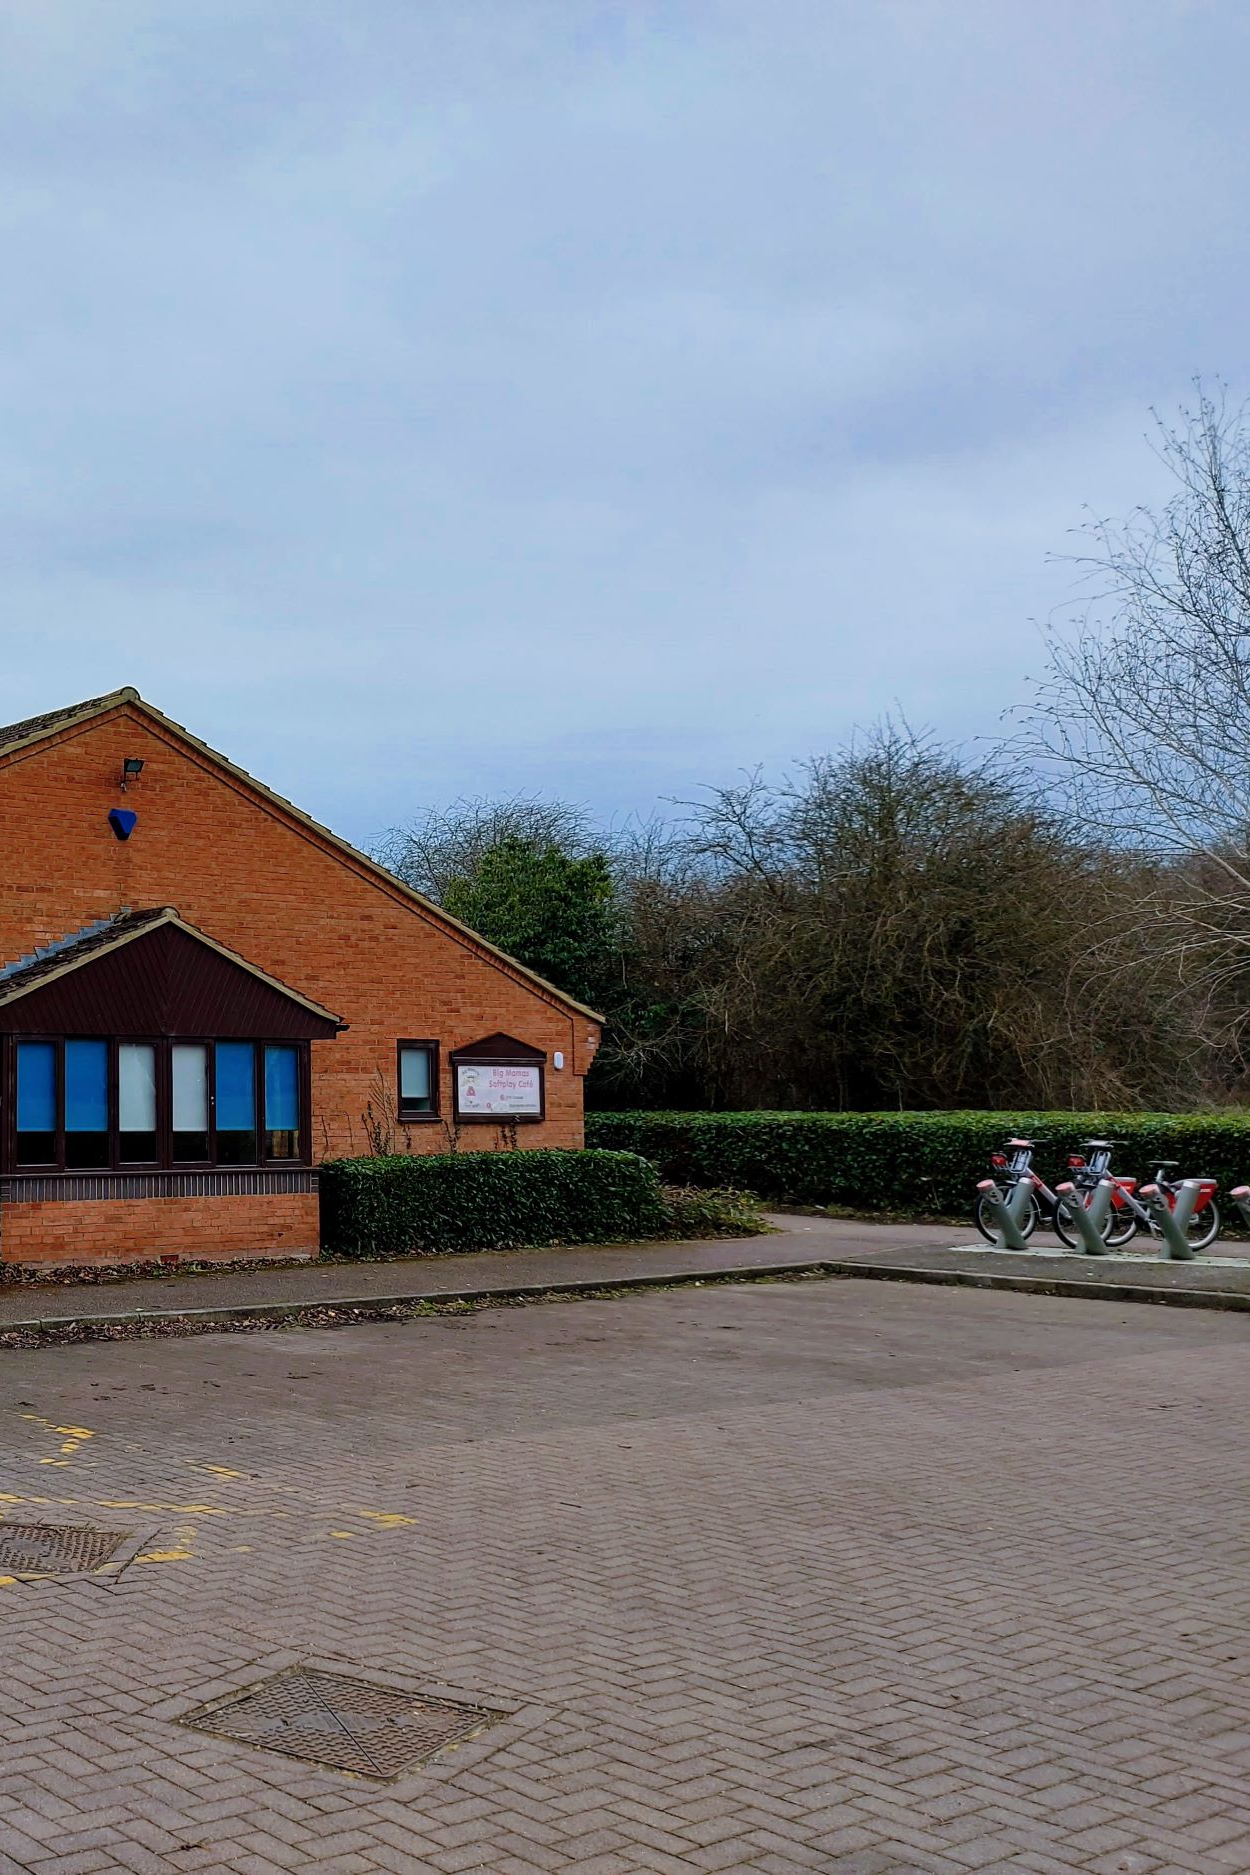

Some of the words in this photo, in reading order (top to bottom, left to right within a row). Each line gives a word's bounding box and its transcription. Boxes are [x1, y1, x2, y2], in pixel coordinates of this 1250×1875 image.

[492, 1068, 504, 1078] Big
[505, 1068, 530, 1077] Mamas
[488, 1079, 517, 1089] Softplay
[518, 1079, 533, 1088] Café
